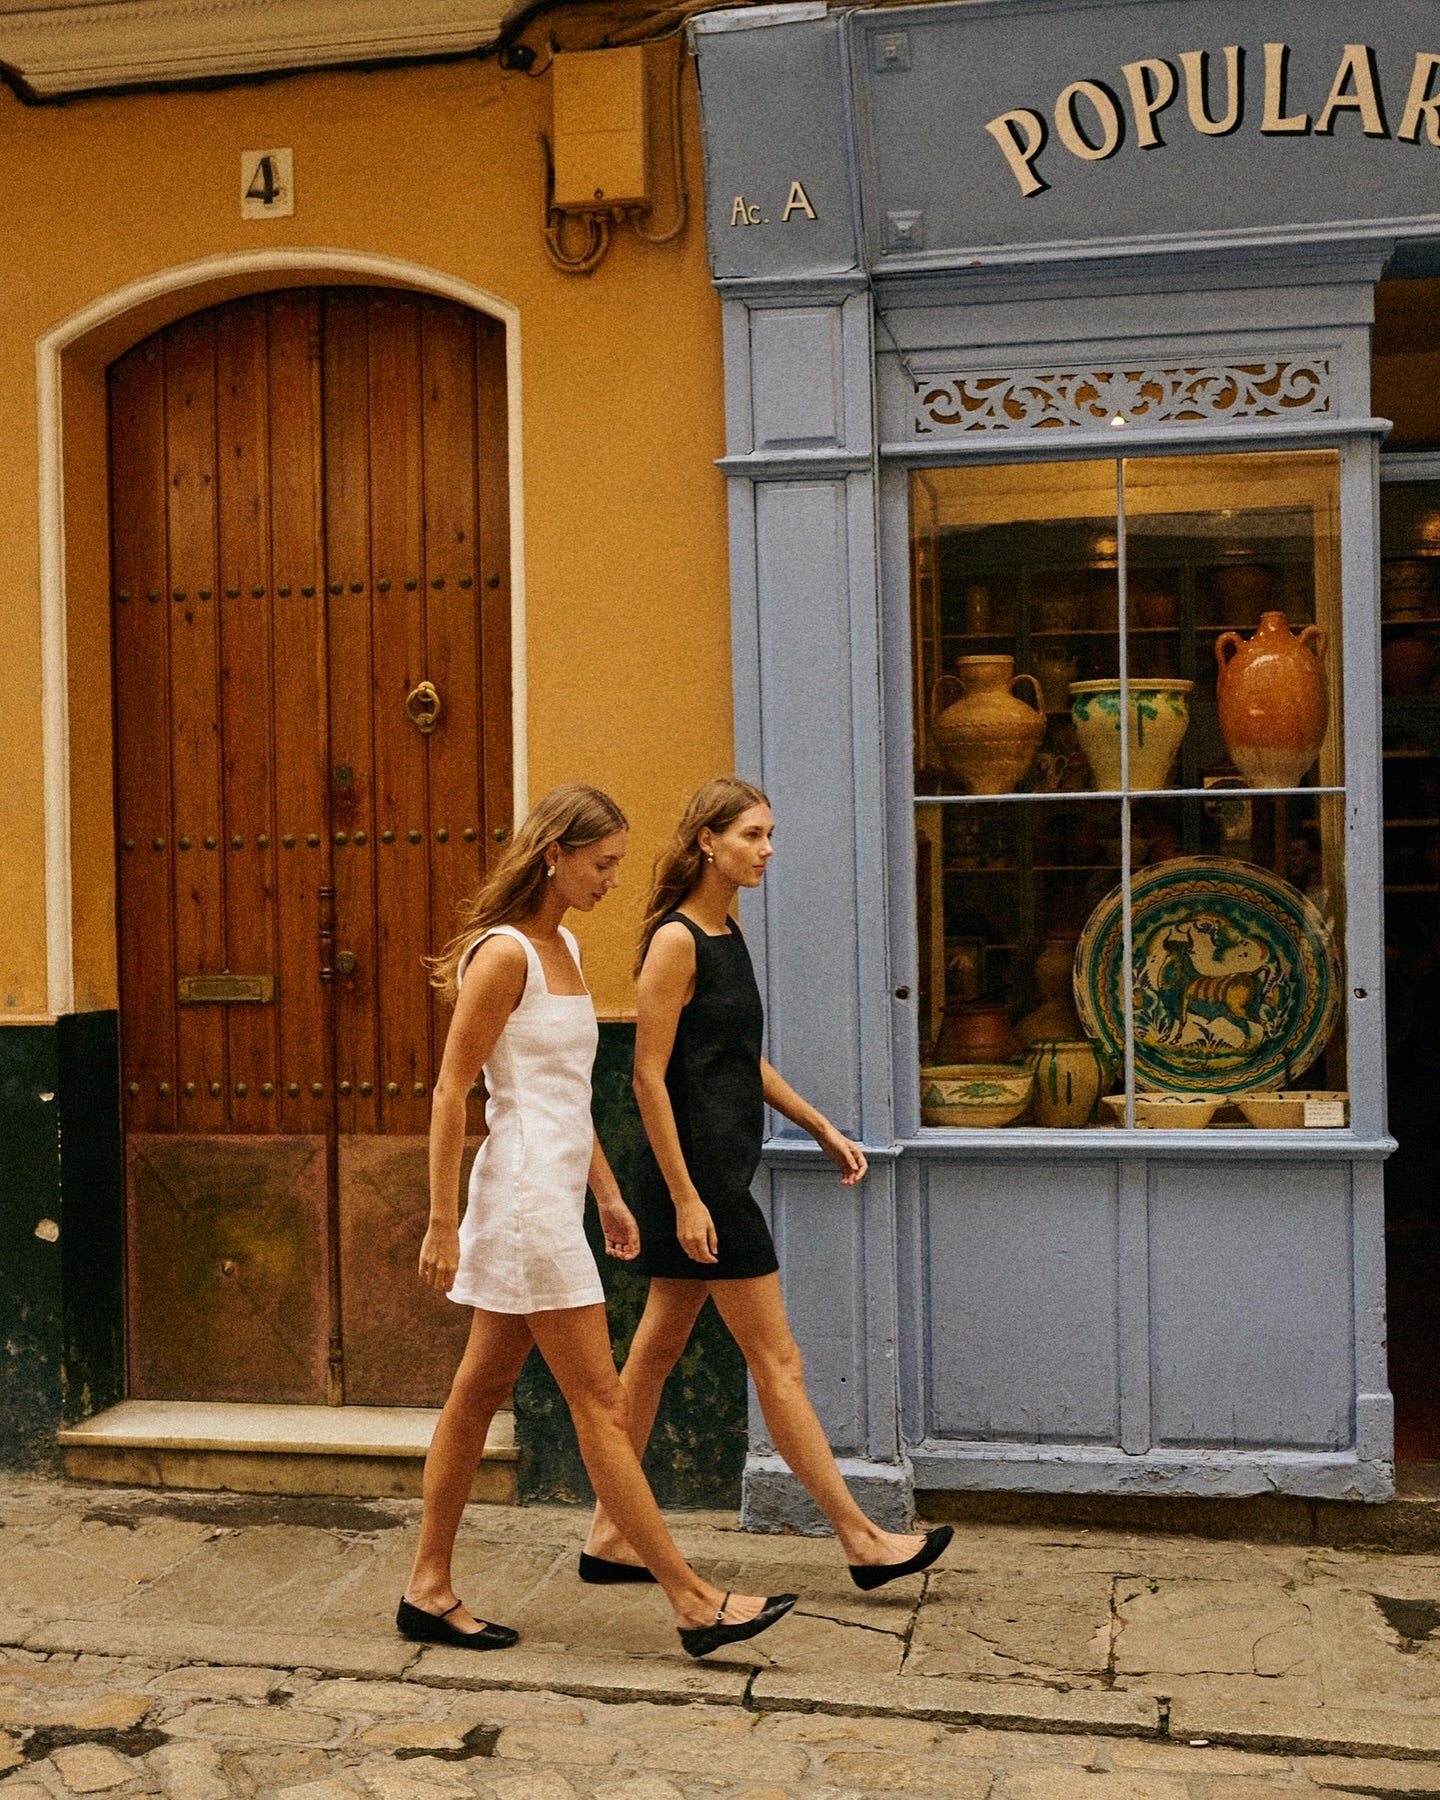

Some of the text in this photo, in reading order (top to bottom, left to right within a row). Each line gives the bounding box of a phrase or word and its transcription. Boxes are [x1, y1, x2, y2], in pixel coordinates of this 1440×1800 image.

[984, 42, 1440, 198] POPULAR
[245, 156, 280, 205] 4
[781, 181, 817, 222] A
